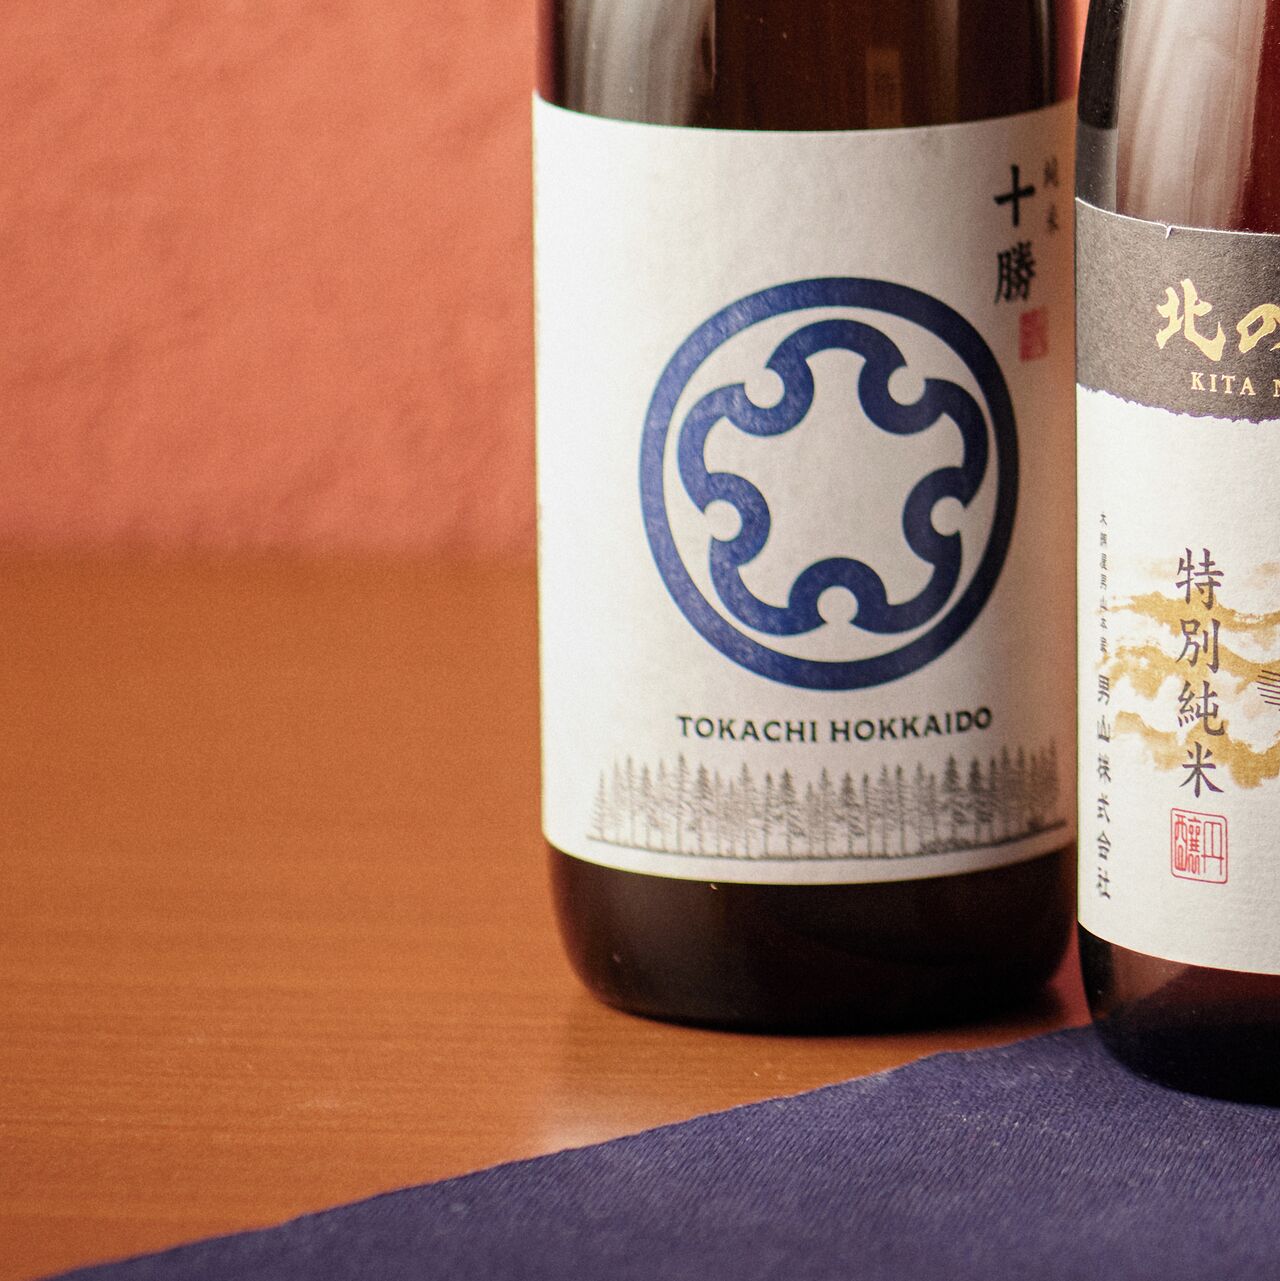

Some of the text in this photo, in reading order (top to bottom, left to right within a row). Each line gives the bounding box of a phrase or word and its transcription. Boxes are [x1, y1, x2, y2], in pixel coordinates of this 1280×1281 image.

[993, 163, 1037, 305] 十勝
[1190, 371, 1257, 397] KITA
[1174, 547, 1226, 799] 特別純米
[676, 705, 994, 742] TOKACHI HOKKAIDO
